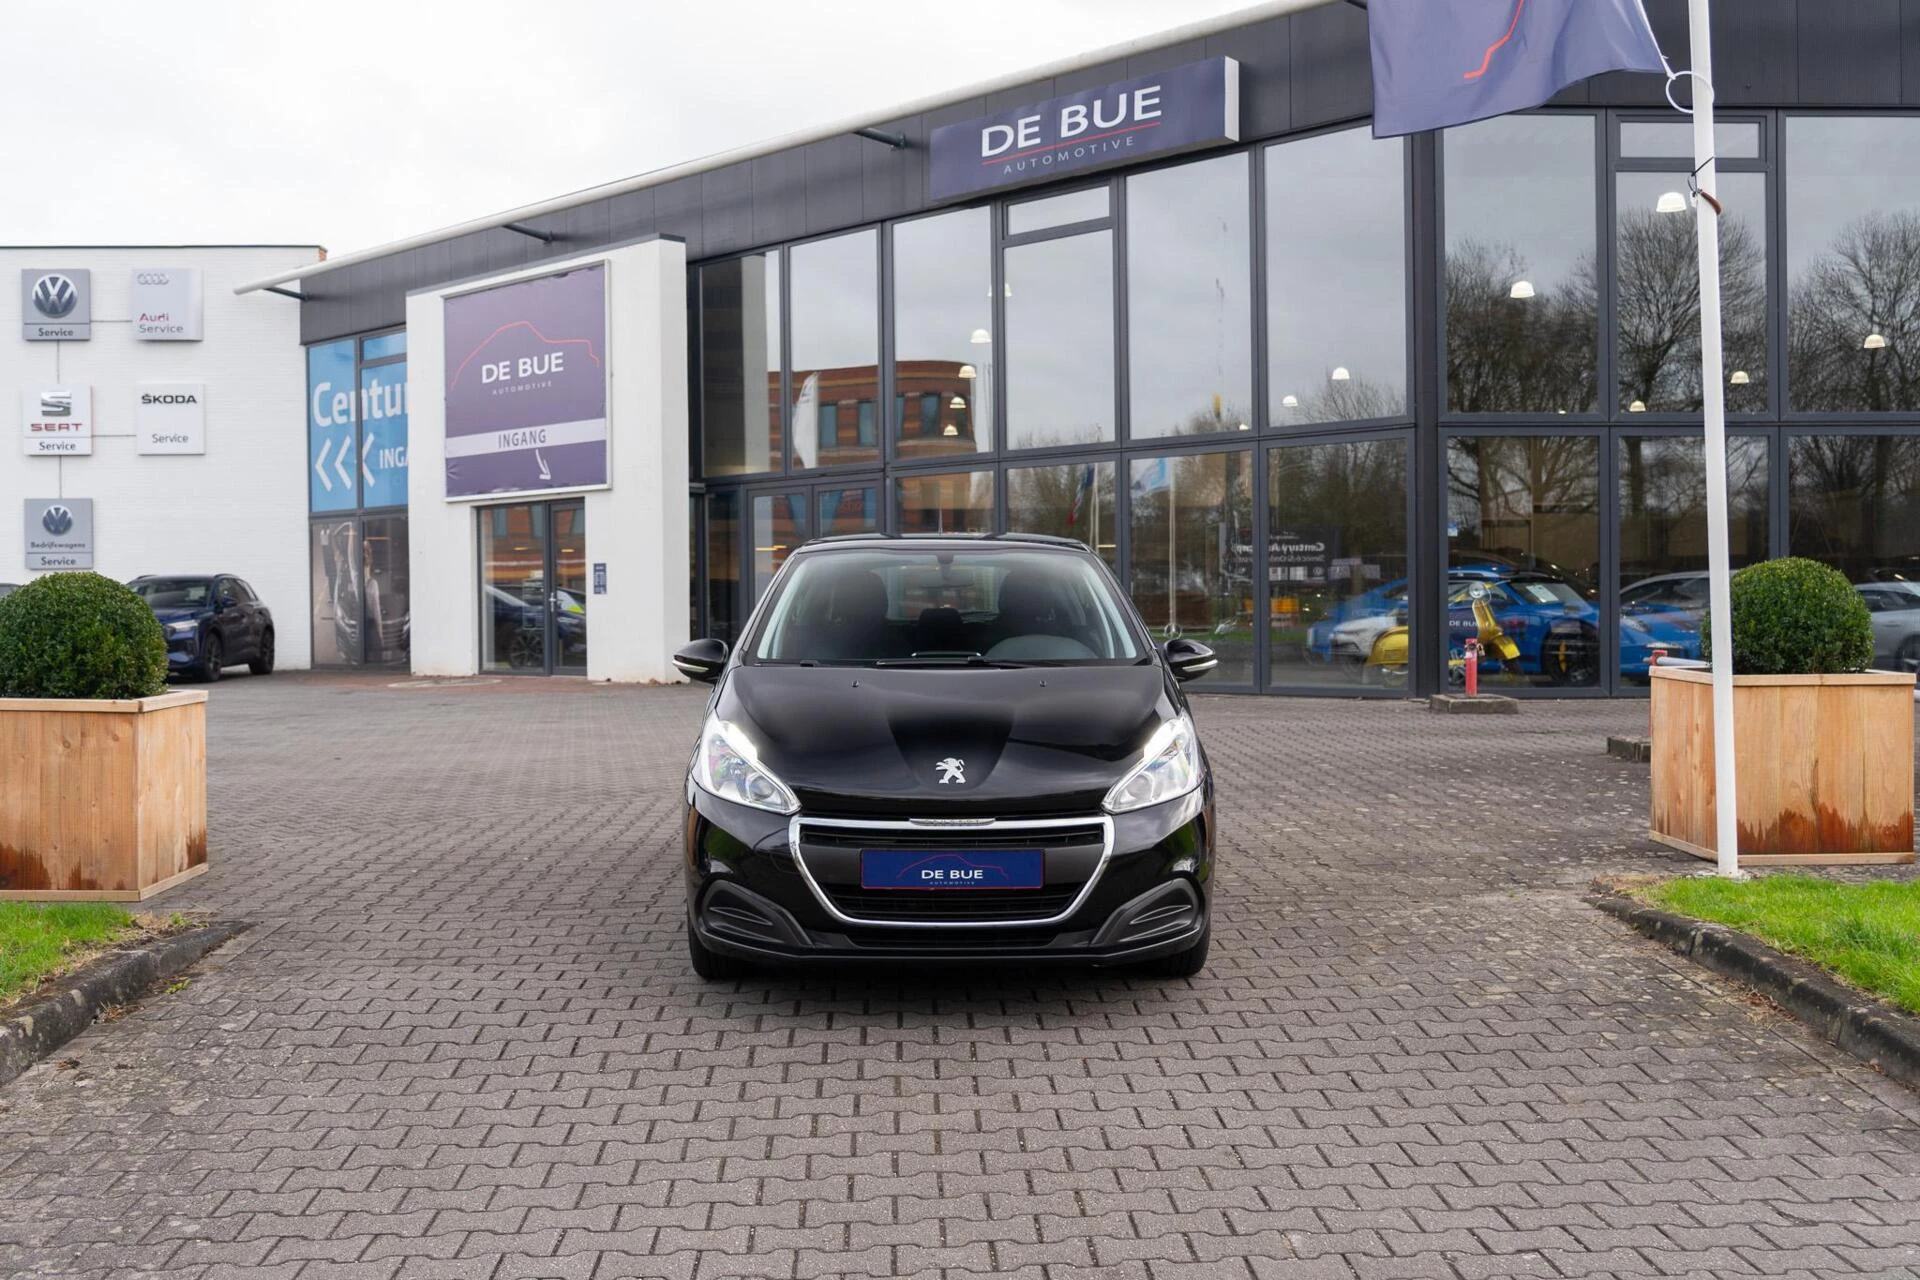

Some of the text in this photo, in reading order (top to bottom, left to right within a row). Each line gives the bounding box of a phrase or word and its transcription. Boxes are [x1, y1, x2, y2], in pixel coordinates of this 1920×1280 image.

[981, 85, 1162, 158] DE BUE
[1003, 136, 1134, 175] AUTOMOTIVE
[139, 313, 169, 322] Audi
[38, 327, 74, 337] Service
[139, 324, 184, 334] Service
[482, 352, 564, 384] DE BUE
[492, 380, 552, 395] AUTOMOTIVE
[141, 393, 197, 404] ŠKODA
[30, 423, 82, 432] SEAT
[151, 433, 189, 443] Service
[498, 429, 546, 449] INGANG
[39, 441, 76, 451] Service
[41, 556, 76, 566] Service
[921, 869, 983, 879] DE BUE
